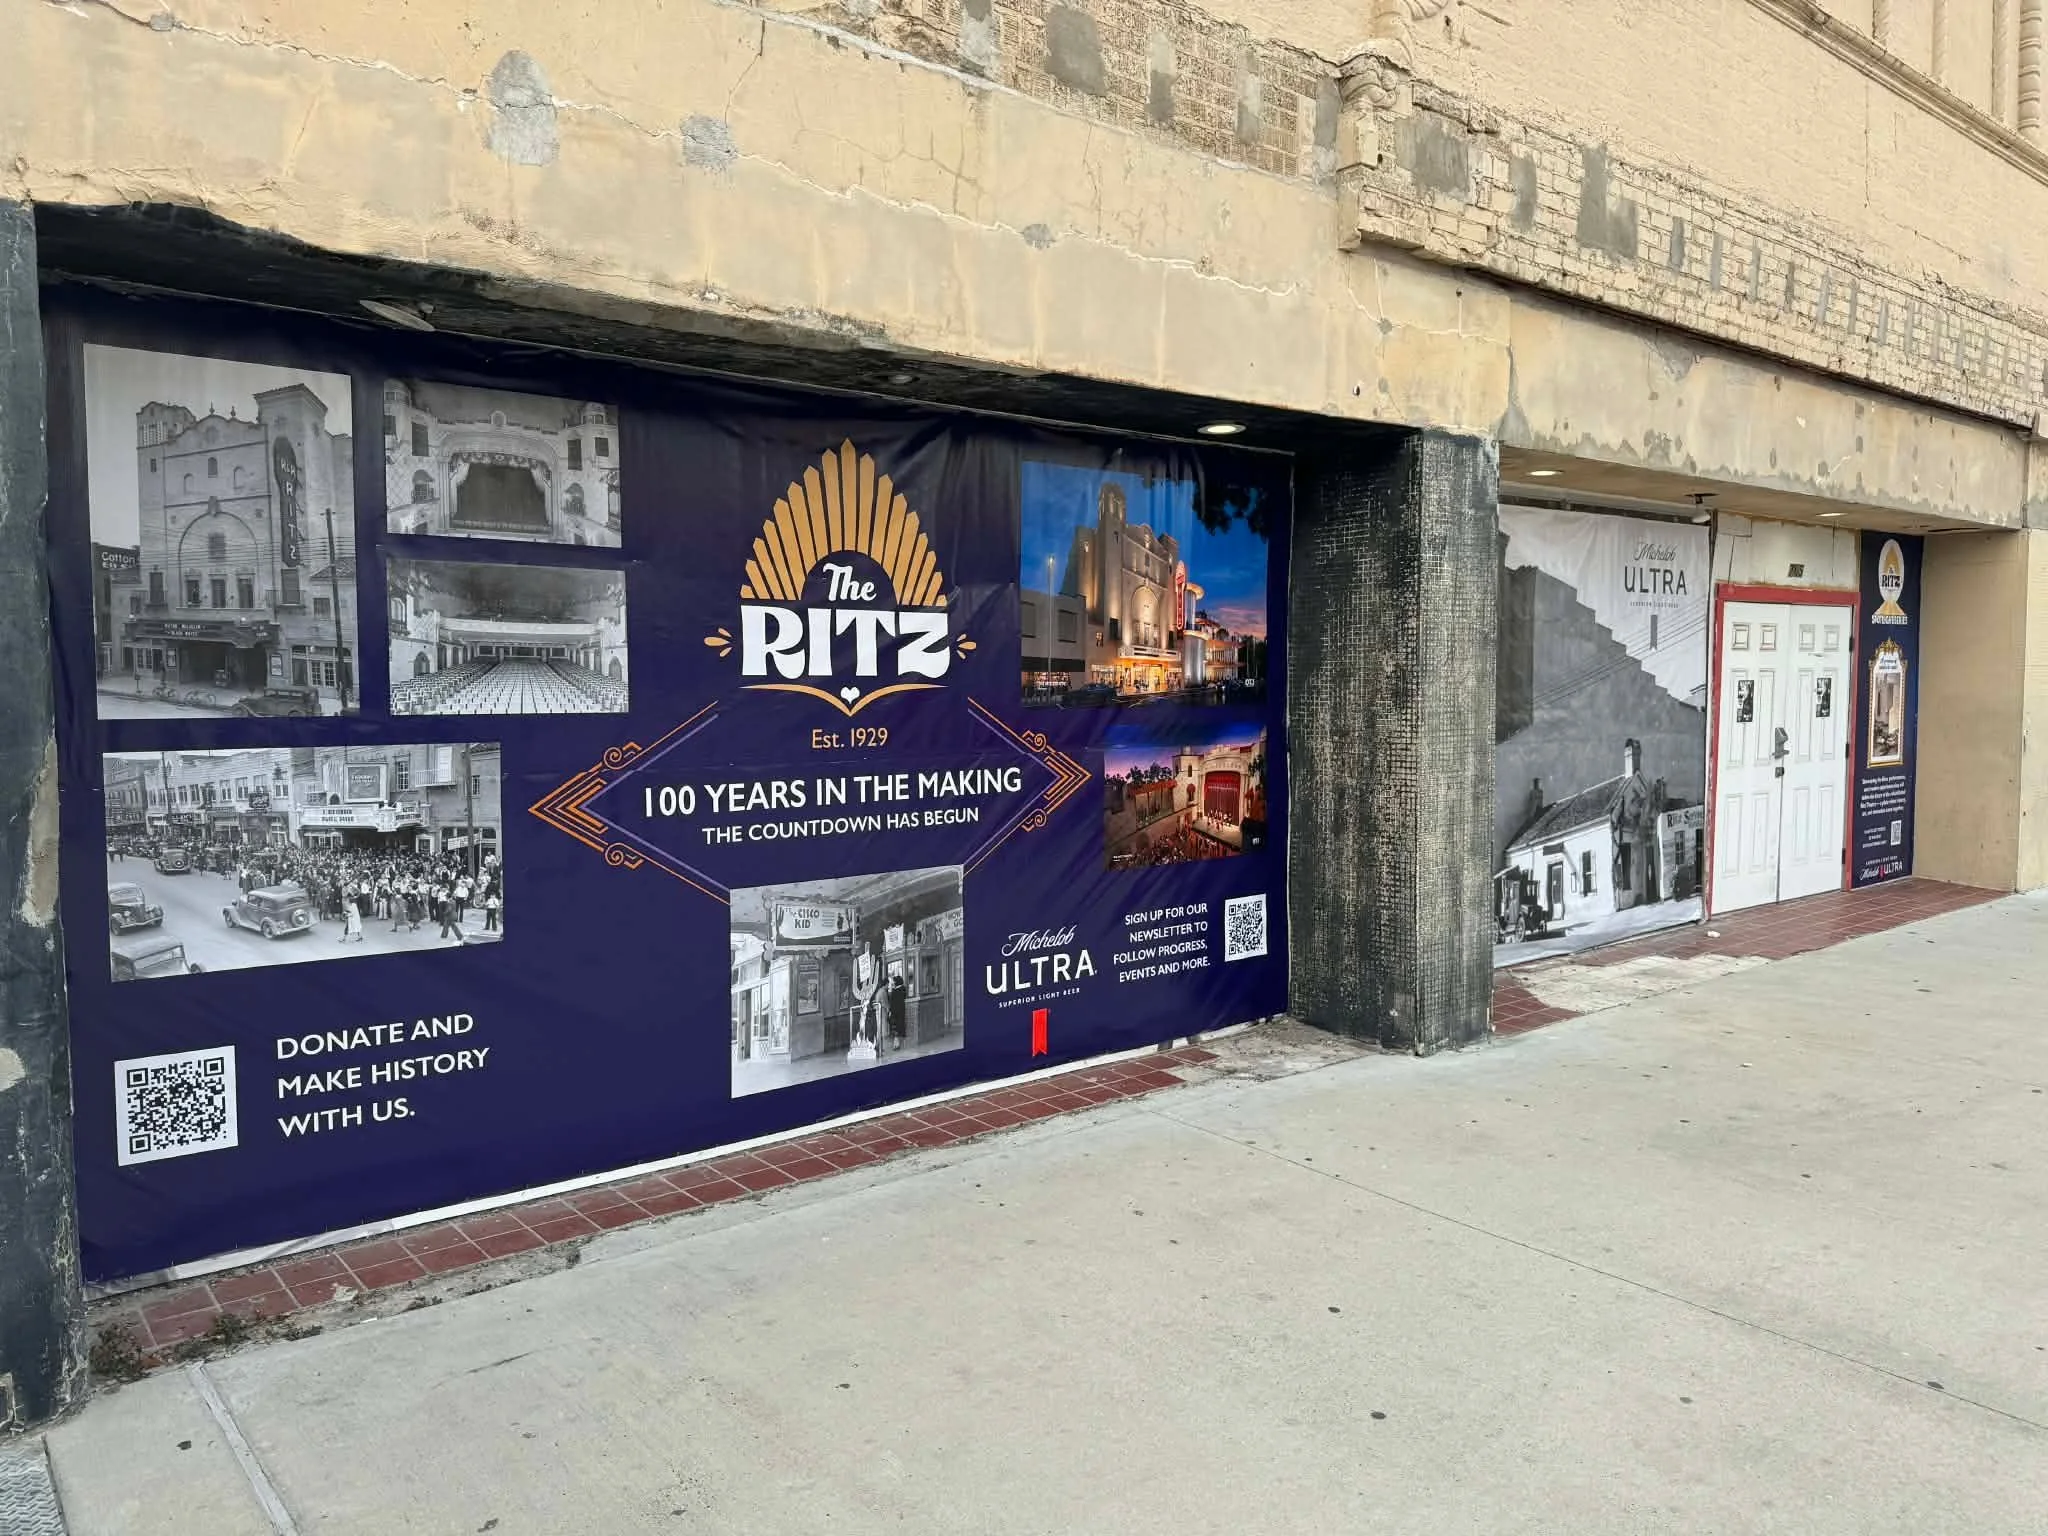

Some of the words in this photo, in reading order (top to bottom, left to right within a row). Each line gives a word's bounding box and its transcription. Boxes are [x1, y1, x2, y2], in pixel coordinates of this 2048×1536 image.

[822, 562, 877, 602] The
[1624, 565, 1687, 596] ULTRA
[1881, 575, 1901, 588] RITZ
[740, 604, 950, 679] RITZ
[812, 728, 844, 749] Est.
[850, 727, 888, 748] 1929
[645, 785, 696, 817] 100
[704, 779, 805, 813] YEARS
[816, 777, 846, 806] IN
[853, 774, 909, 803] THE
[918, 767, 1022, 798] MAKING
[702, 826, 742, 845] THE
[748, 815, 882, 841] COUNTDOWN
[887, 812, 919, 830] HAS
[924, 807, 979, 827] BEGUN
[794, 919, 811, 929] KID
[1125, 912, 1148, 926] SIGN
[1150, 909, 1163, 921] UP
[1165, 907, 1184, 919] FOR
[1186, 903, 1208, 915] OUR
[1001, 925, 1078, 957] Michelob
[1129, 923, 1192, 943] NEWSLETTER
[1194, 921, 1208, 933] TO
[1113, 946, 1156, 965] FOLLOW
[1158, 939, 1208, 957] PROGRESS,
[986, 949, 1095, 995] ULTRA
[1119, 965, 1156, 983] EVENTS
[1158, 962, 1180, 976] AND
[1182, 956, 1211, 971] MORE.
[998, 996, 1035, 1009] SUPERIOR
[1038, 991, 1060, 1001] LIGHT
[276, 1022, 404, 1060] DONATE
[410, 1013, 474, 1041] AND
[277, 1066, 362, 1099] MAKE
[371, 1047, 491, 1085] HISTORY
[277, 1105, 363, 1138] WITH
[371, 1097, 416, 1123] US.
